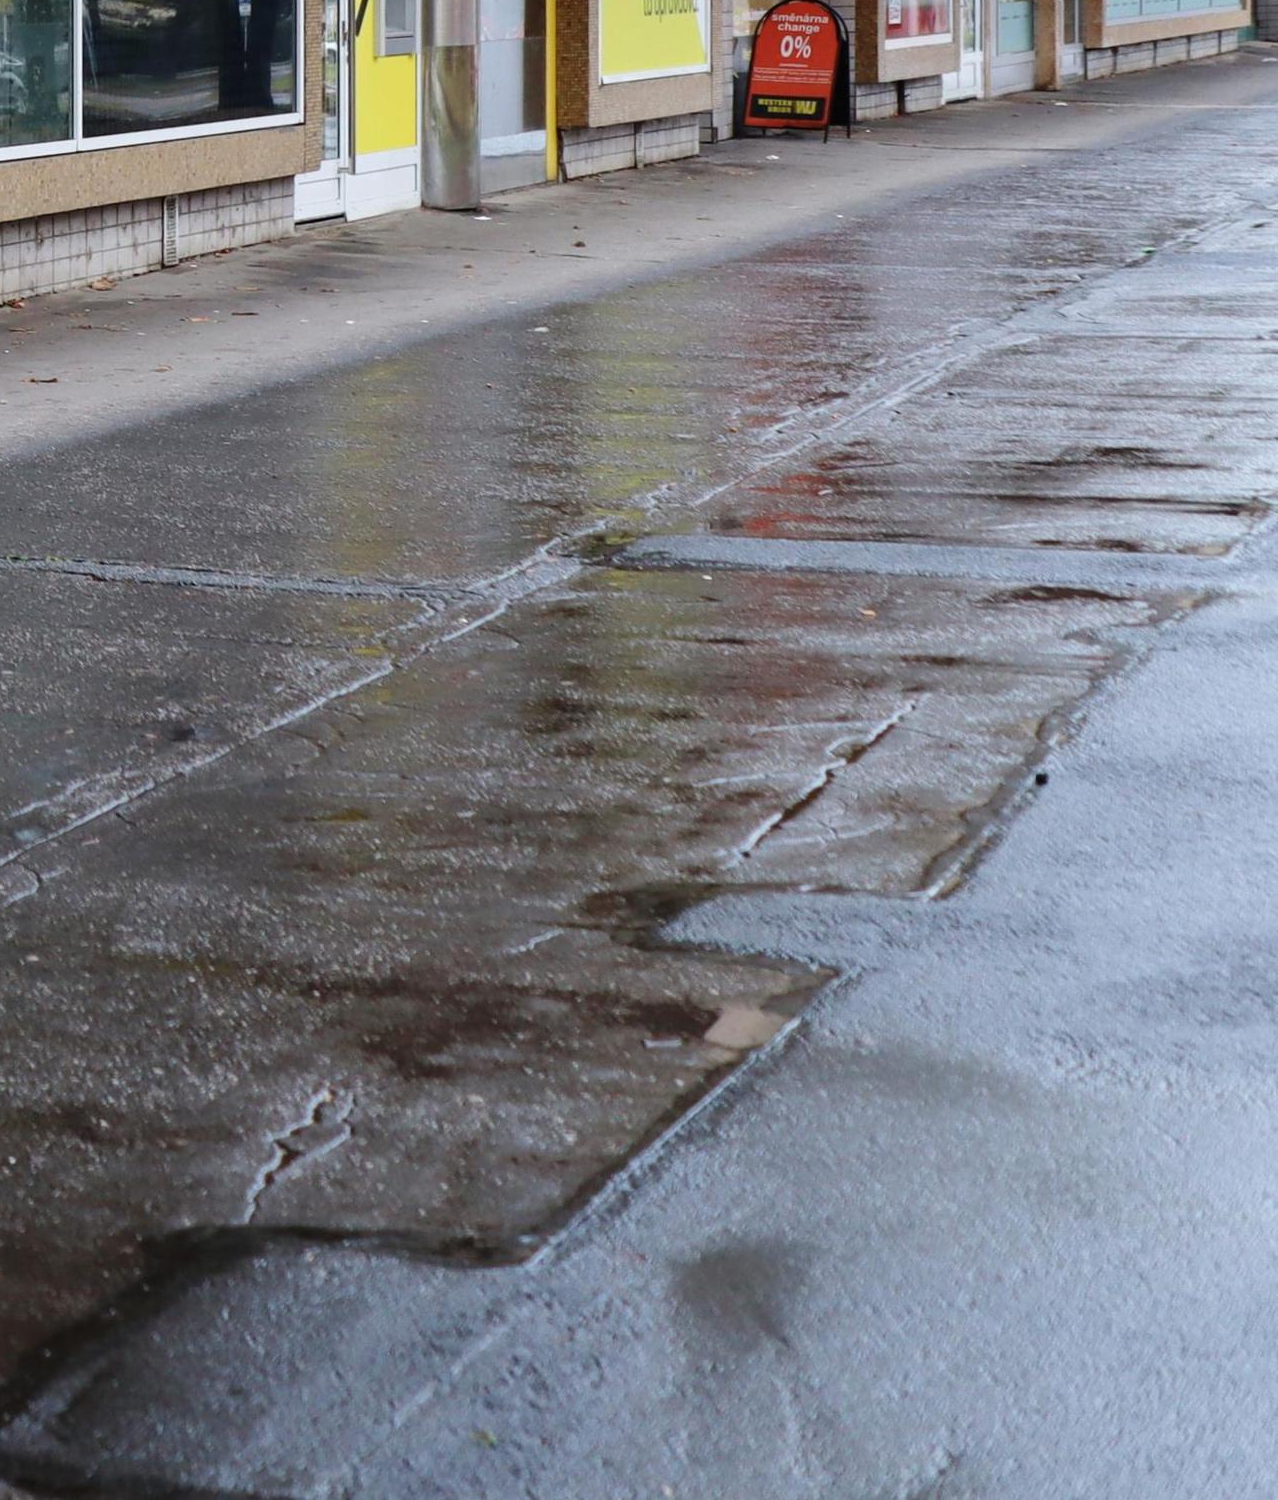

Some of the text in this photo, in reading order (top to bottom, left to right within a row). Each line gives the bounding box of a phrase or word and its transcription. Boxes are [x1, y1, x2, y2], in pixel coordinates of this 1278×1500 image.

[771, 13, 829, 24] směnárna
[777, 22, 820, 34] change
[780, 35, 811, 59] 0%
